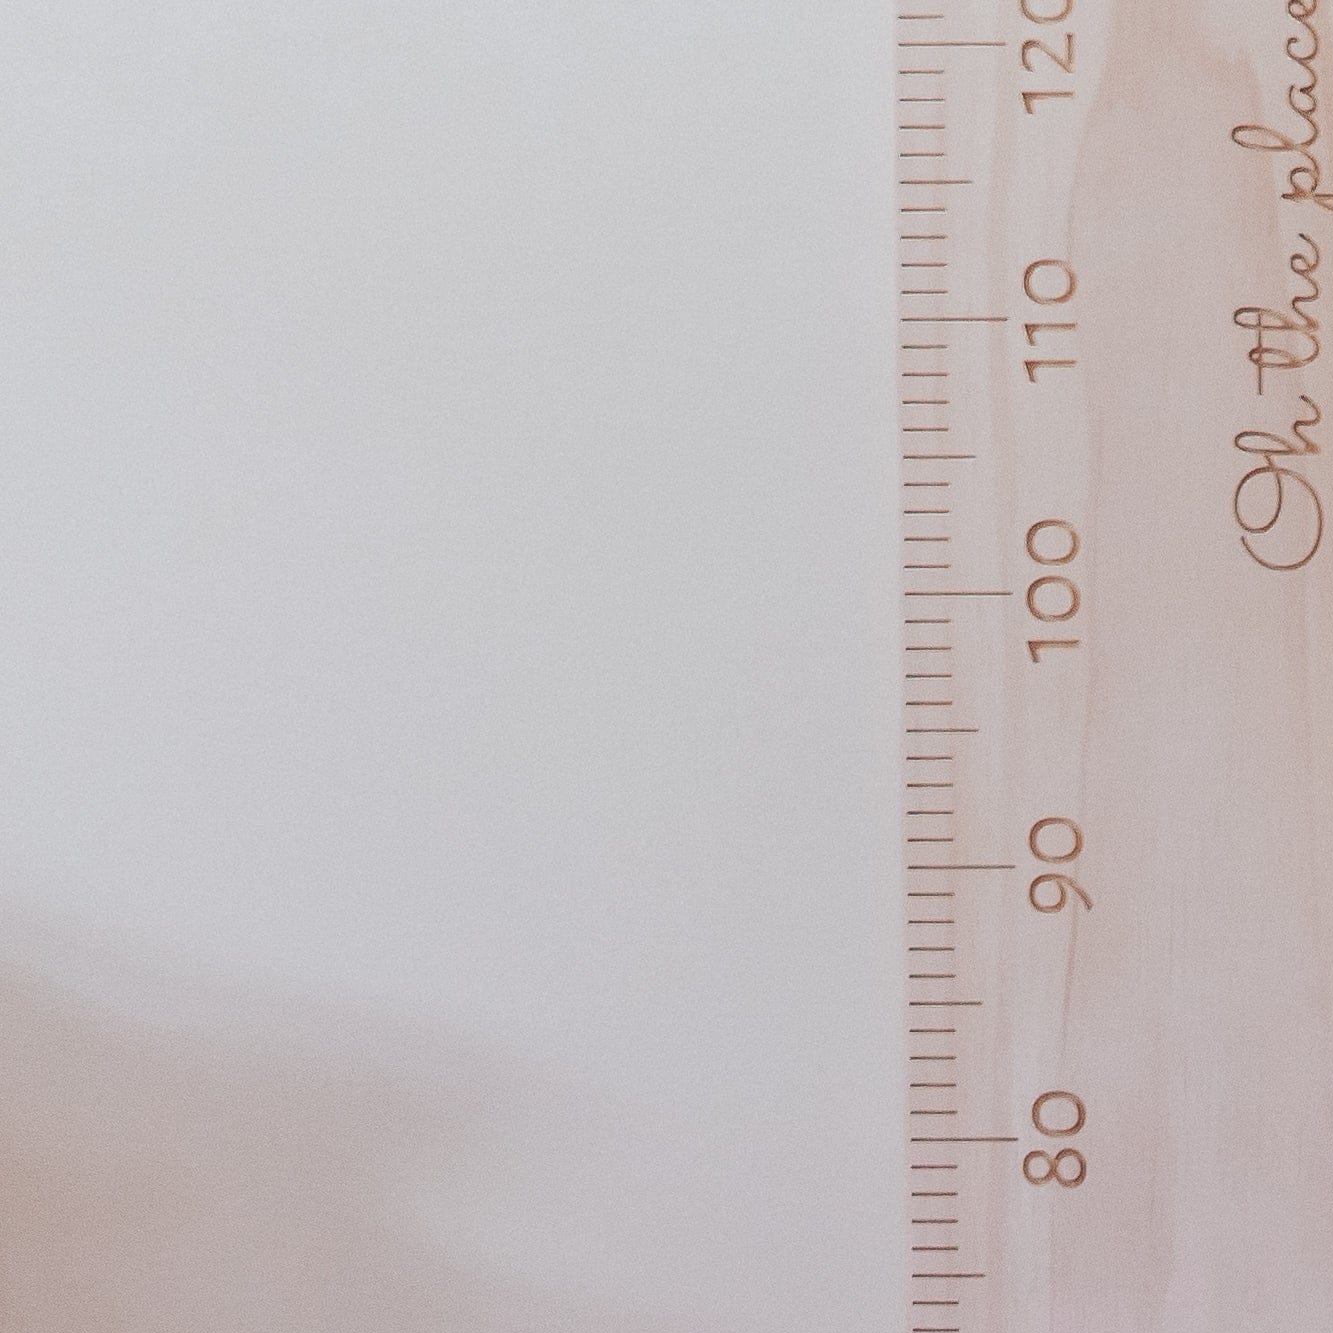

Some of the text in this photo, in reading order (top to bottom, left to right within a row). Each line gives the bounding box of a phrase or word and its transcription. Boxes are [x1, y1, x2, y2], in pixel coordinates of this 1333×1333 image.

[1022, 259, 1078, 383] 110
[1232, 232, 1322, 395] the
[1233, 395, 1323, 571] Oh
[1025, 518, 1081, 663] 100
[1028, 817, 1094, 914] 90
[1022, 1090, 1087, 1187] 80
